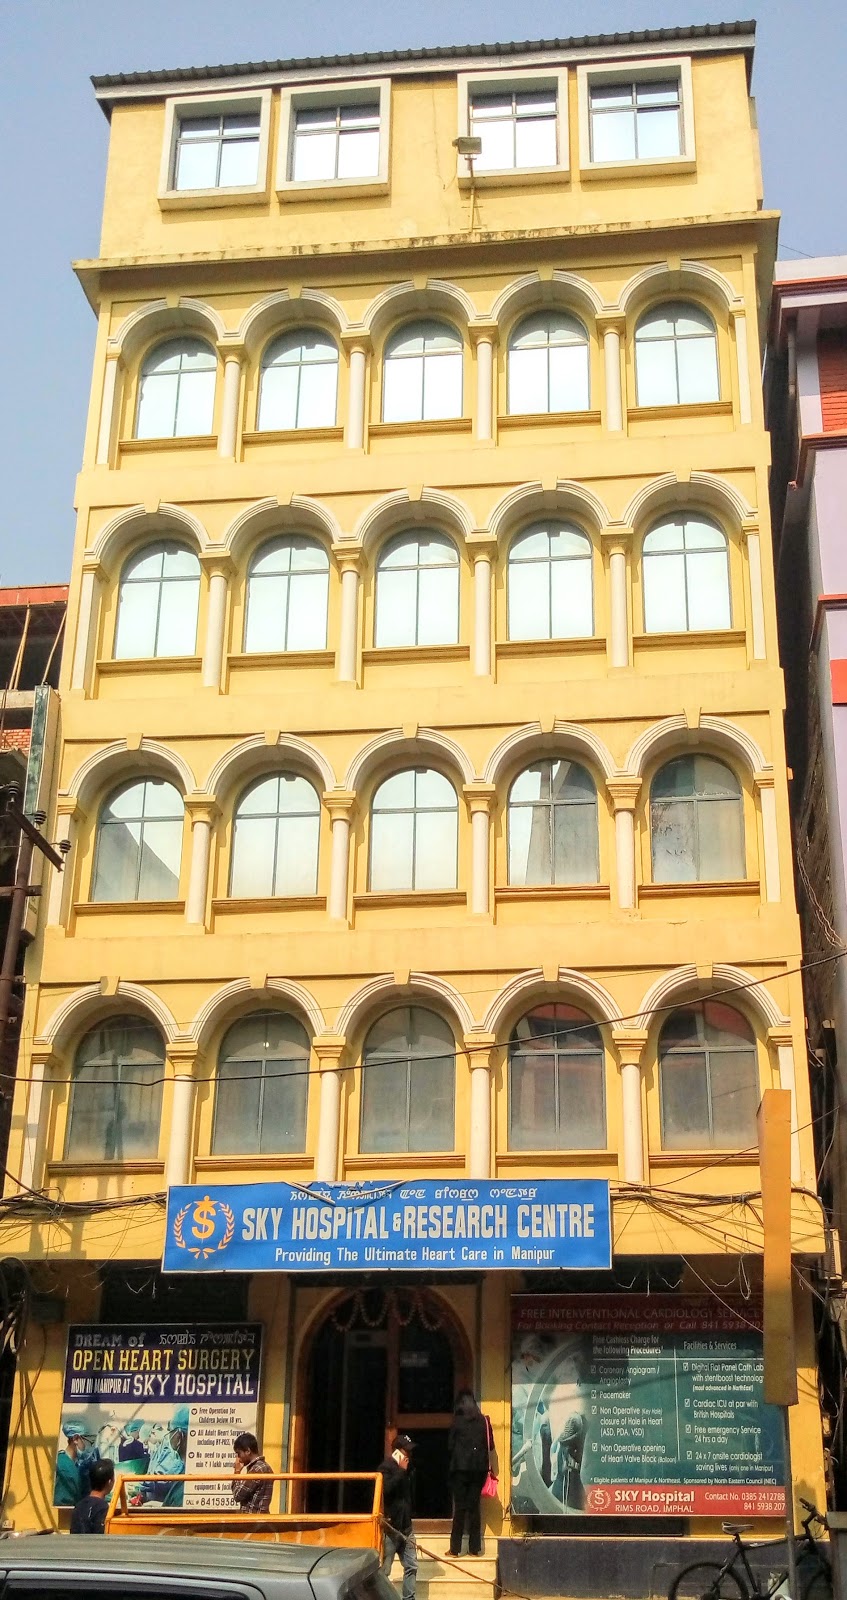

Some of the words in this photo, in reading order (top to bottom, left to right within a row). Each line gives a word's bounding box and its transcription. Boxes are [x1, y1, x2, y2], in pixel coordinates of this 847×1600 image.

[242, 1207, 283, 1241] SKY
[291, 1206, 389, 1240] HOSPITAL
[403, 1205, 507, 1239] RESEARCH
[517, 1204, 595, 1238] CENTRE
[275, 1247, 331, 1265] Providing
[337, 1247, 358, 1261] The
[365, 1246, 417, 1261] Ultimate
[422, 1246, 456, 1261] Heart
[461, 1246, 487, 1261] Care
[493, 1245, 504, 1260] in
[511, 1246, 555, 1264] Manipur
[520, 1309, 546, 1319] FREE
[548, 1308, 640, 1319] INTERVENTIONAL
[643, 1308, 713, 1319] CARDIOLOGY
[517, 1322, 532, 1330] For
[575, 1321, 611, 1330] Contact
[613, 1321, 659, 1331] Reception
[679, 1321, 697, 1330] Call
[701, 1321, 718, 1329] 841
[722, 1321, 746, 1330] 5938
[75, 1334, 122, 1347] DREAM
[128, 1333, 146, 1347] of
[593, 1336, 604, 1344] Free
[631, 1335, 650, 1345] Charge
[651, 1335, 659, 1344] for
[684, 1341, 708, 1350] Facilities
[709, 1341, 714, 1350] &
[714, 1341, 737, 1350] Services
[593, 1346, 602, 1354] the
[604, 1346, 630, 1356] following
[72, 1349, 115, 1371] OPEN
[119, 1349, 174, 1371] HEART
[177, 1348, 256, 1371] SURGERY
[599, 1366, 624, 1374] Coronary
[626, 1366, 656, 1375] Angiogram
[691, 1362, 709, 1372] Digital
[722, 1362, 737, 1371] Panel
[738, 1362, 752, 1371] Cath
[753, 1362, 764, 1371] Lab
[600, 1377, 632, 1386] Angioplasty
[692, 1374, 704, 1382] with
[70, 1378, 86, 1393] NOW
[86, 1378, 93, 1393] IN
[94, 1378, 122, 1393] MANIPUR
[122, 1378, 131, 1393] AT
[133, 1374, 171, 1396] SKY
[174, 1373, 254, 1396] HOSPITAL
[599, 1390, 631, 1399] Pacemaker
[693, 1399, 716, 1408] Cardiac
[717, 1399, 727, 1408] ICU
[728, 1399, 735, 1408] at
[735, 1400, 745, 1409] par
[746, 1399, 758, 1408] with
[209, 1407, 229, 1415] Operation
[600, 1406, 611, 1415] Non
[612, 1406, 640, 1415] Operative
[693, 1410, 709, 1419] British
[710, 1410, 734, 1420] Hospitals
[199, 1416, 216, 1424] Children
[600, 1417, 620, 1426] closure
[621, 1417, 627, 1426] of
[628, 1417, 640, 1426] Hole
[641, 1417, 647, 1426] in
[647, 1417, 663, 1426] Heart
[204, 1429, 217, 1437] Adult
[218, 1429, 229, 1437] Heart
[600, 1428, 616, 1437] (ASD,
[631, 1428, 645, 1438] VSD)
[694, 1425, 706, 1434] Free
[707, 1426, 740, 1435] emergency
[741, 1425, 761, 1434] Service
[694, 1435, 701, 1443] 24
[702, 1435, 710, 1443] hrs
[717, 1435, 728, 1444] day
[600, 1444, 612, 1452] Non
[613, 1443, 641, 1453] Operative
[642, 1443, 666, 1454] opening
[196, 1451, 202, 1459] No
[205, 1451, 214, 1459] need
[600, 1454, 607, 1463] of
[608, 1454, 623, 1463] Heart
[624, 1454, 640, 1463] Valve
[641, 1454, 657, 1463] Block
[695, 1452, 702, 1460] 24
[713, 1451, 729, 1460] onsite
[730, 1451, 763, 1462] cardiologist
[212, 1460, 222, 1468] lakh
[696, 1463, 714, 1472] saving
[715, 1463, 727, 1471] lives
[683, 1477, 707, 1485] Sponsored
[707, 1477, 713, 1485] by
[194, 1482, 216, 1491] equipment
[614, 1490, 639, 1502] SKY
[641, 1490, 695, 1504] Hospital
[704, 1492, 728, 1501] Contact
[729, 1492, 740, 1501] No.
[741, 1492, 757, 1501] 0385
[615, 1504, 634, 1512] RIMS
[635, 1504, 661, 1513] ROAD,
[663, 1504, 694, 1513] IMPHAL
[743, 1502, 755, 1511] 841
[757, 1502, 773, 1511] 5938
[774, 1502, 786, 1511] 207
